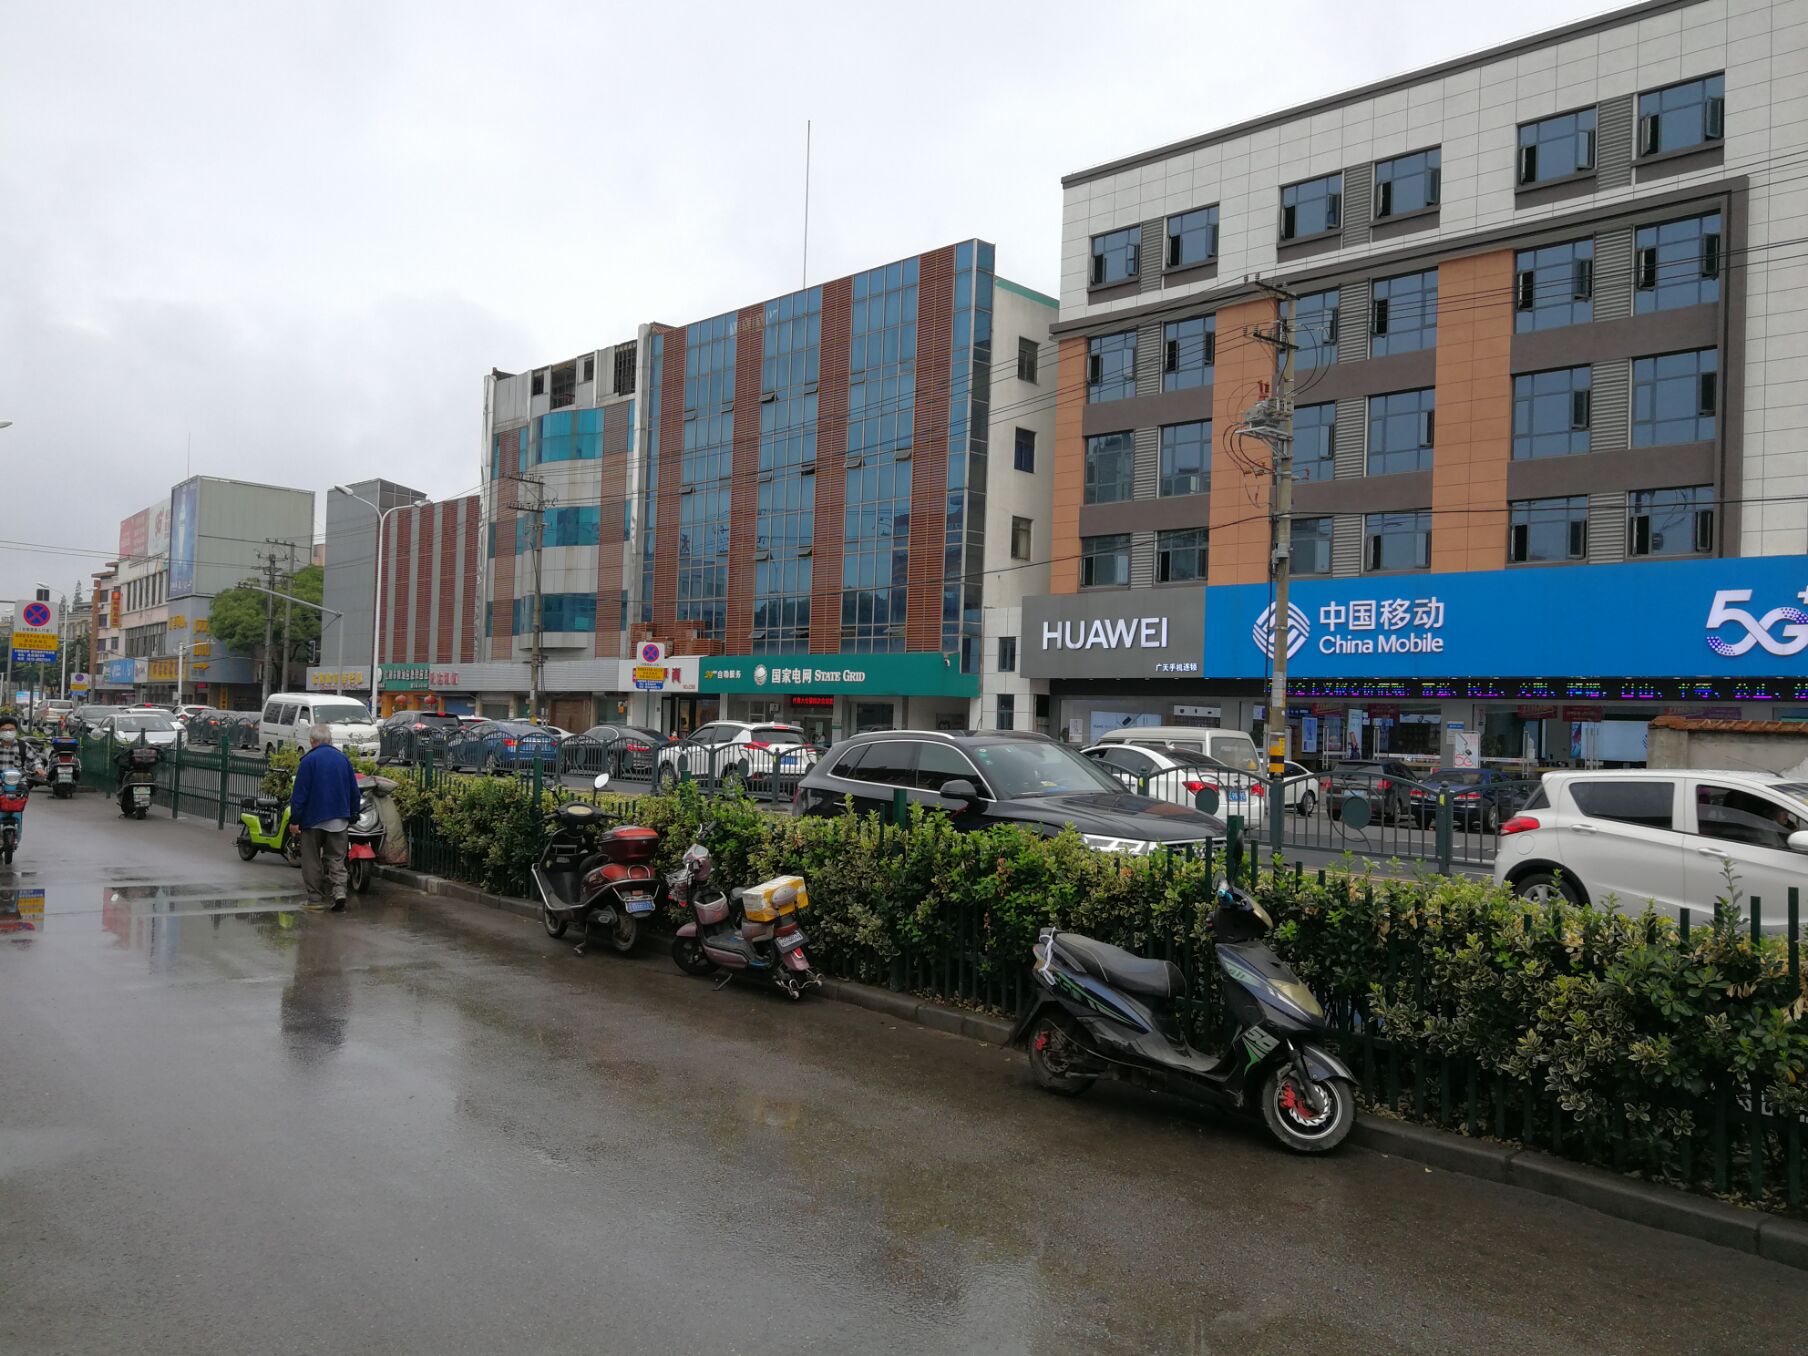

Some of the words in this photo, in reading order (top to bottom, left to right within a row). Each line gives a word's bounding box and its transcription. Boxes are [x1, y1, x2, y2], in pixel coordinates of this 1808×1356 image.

[1319, 597, 1445, 632] 中国移动
[1042, 617, 1168, 650] HUAWEI
[1319, 635, 1374, 654] China
[1377, 632, 1444, 653] Mobile
[771, 667, 812, 684] 国家电网
[814, 669, 841, 682] STATE
[842, 669, 866, 682] GRID
